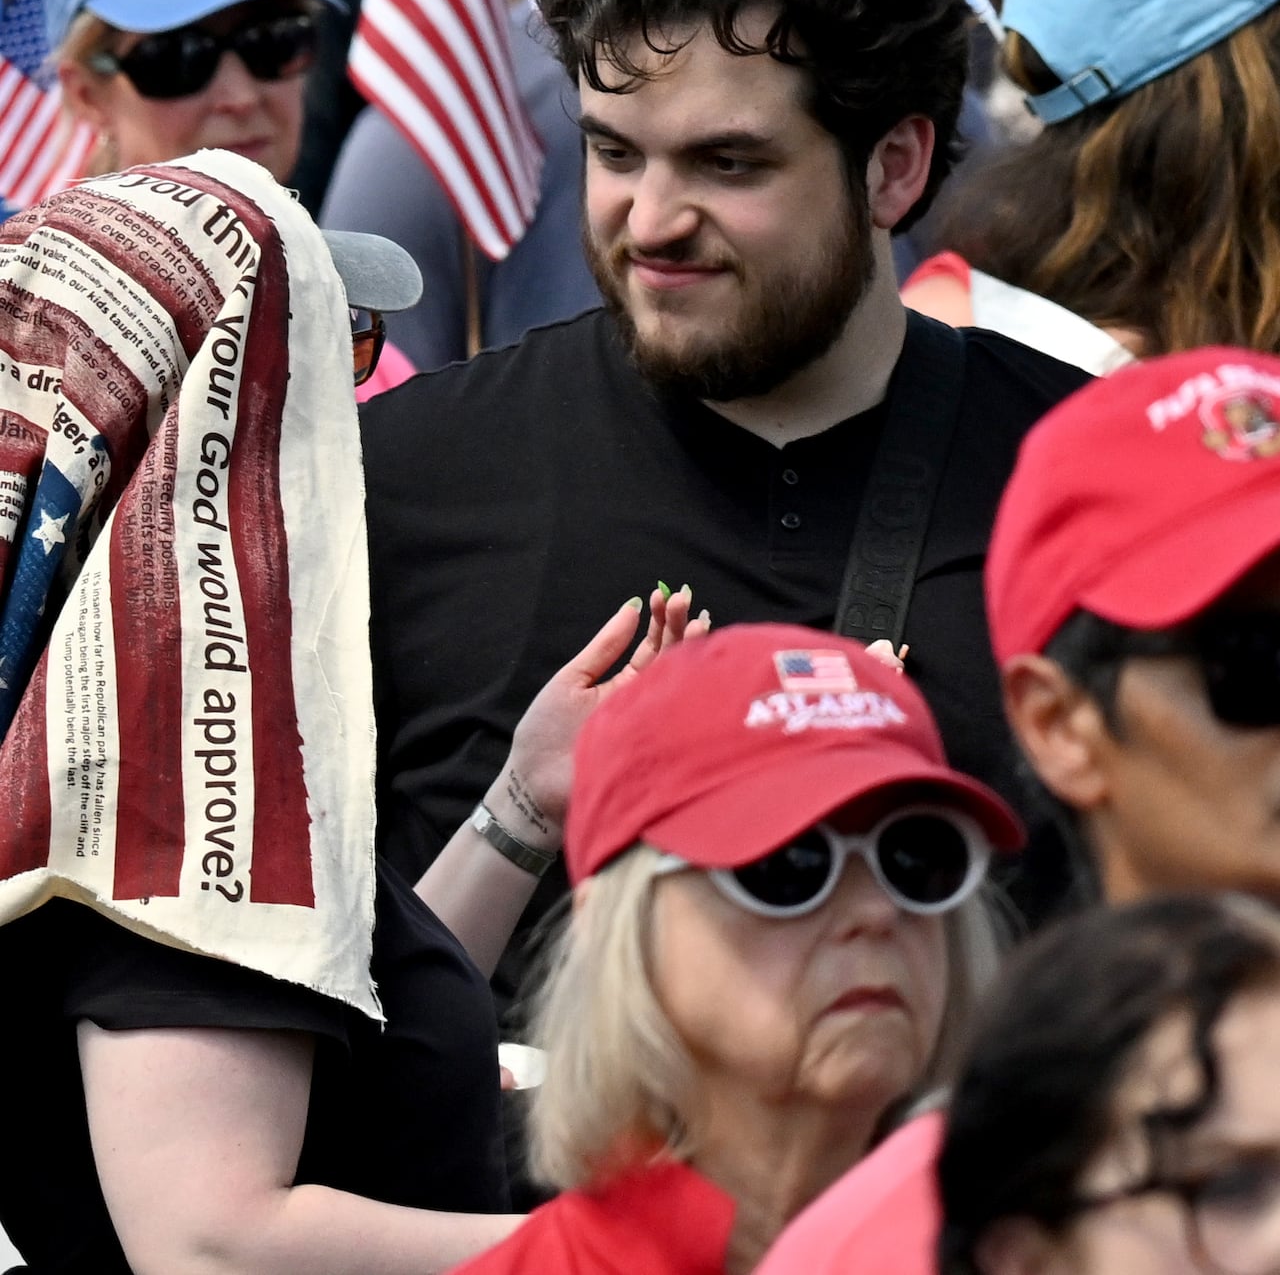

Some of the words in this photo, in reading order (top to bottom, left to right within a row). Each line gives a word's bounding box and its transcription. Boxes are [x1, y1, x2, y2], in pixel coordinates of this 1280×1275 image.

[97, 205, 117, 217] all
[115, 212, 163, 249] deeper
[161, 247, 188, 275] into
[187, 276, 197, 288] a
[194, 288, 217, 324] spira
[101, 223, 138, 253] every
[138, 250, 177, 286] crack
[175, 283, 188, 301] in
[68, 279, 88, 294] our
[86, 290, 110, 315] kids
[108, 312, 145, 348] taught
[140, 347, 161, 370] and
[81, 351, 99, 370] as
[96, 368, 108, 381] a
[206, 315, 245, 421] your
[162, 410, 179, 470] national
[192, 432, 231, 532] God
[141, 480, 158, 542] fascists
[157, 472, 176, 534] security
[141, 543, 153, 568] are
[79, 587, 89, 607] with
[93, 587, 103, 620] insane
[197, 543, 248, 672] would
[77, 607, 89, 644] Reagan
[93, 621, 103, 642] how
[63, 631, 75, 662] Trump
[78, 645, 90, 674] being
[94, 643, 104, 658] far
[80, 675, 91, 692] the
[95, 660, 105, 677] the
[64, 663, 77, 716] potentially
[81, 693, 92, 714] first
[94, 679, 107, 738] Republican
[743, 690, 907, 727] ATLANTA
[65, 716, 77, 745] being
[79, 715, 91, 746] major
[67, 746, 78, 765] the
[79, 748, 92, 772] step
[95, 739, 108, 769] party
[80, 773, 92, 790] off
[95, 770, 107, 791] has
[193, 687, 245, 904] approve?
[80, 792, 91, 811] the
[93, 792, 106, 824] fallen
[78, 812, 90, 834] cliff
[75, 835, 87, 858] and
[91, 826, 103, 857] since
